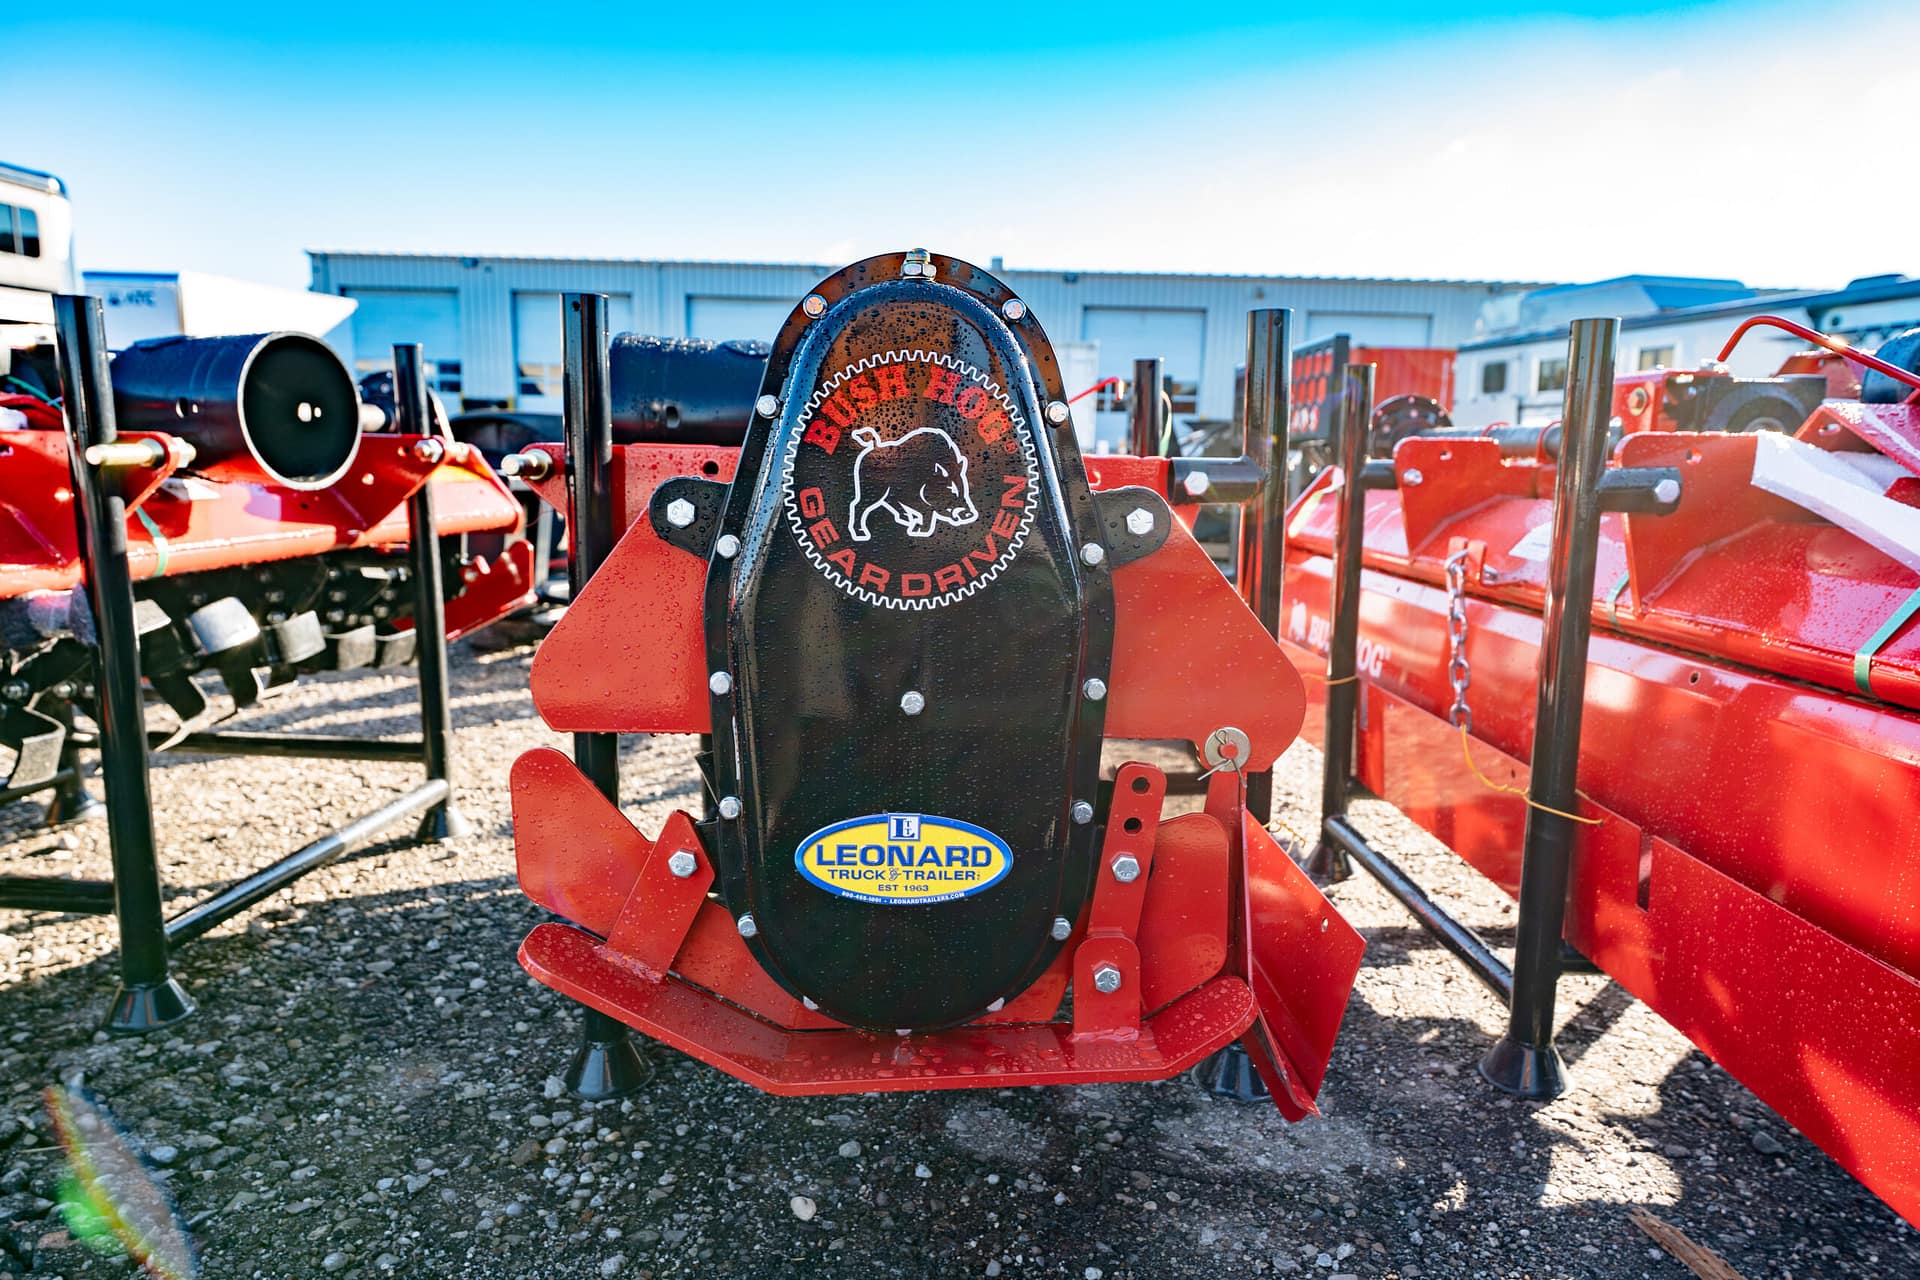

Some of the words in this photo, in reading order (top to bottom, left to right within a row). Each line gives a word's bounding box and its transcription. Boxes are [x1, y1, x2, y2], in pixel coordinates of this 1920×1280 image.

[804, 364, 912, 455] BUSH
[800, 486, 892, 593] GEAR
[901, 475, 1027, 597] DRIVEN
[816, 844, 992, 867] LEONARD
[828, 869, 886, 880] TRUCK
[889, 867, 901, 881] &
[903, 870, 976, 881] TRAILER
[878, 884, 899, 892] EST
[904, 884, 929, 892] 1963
